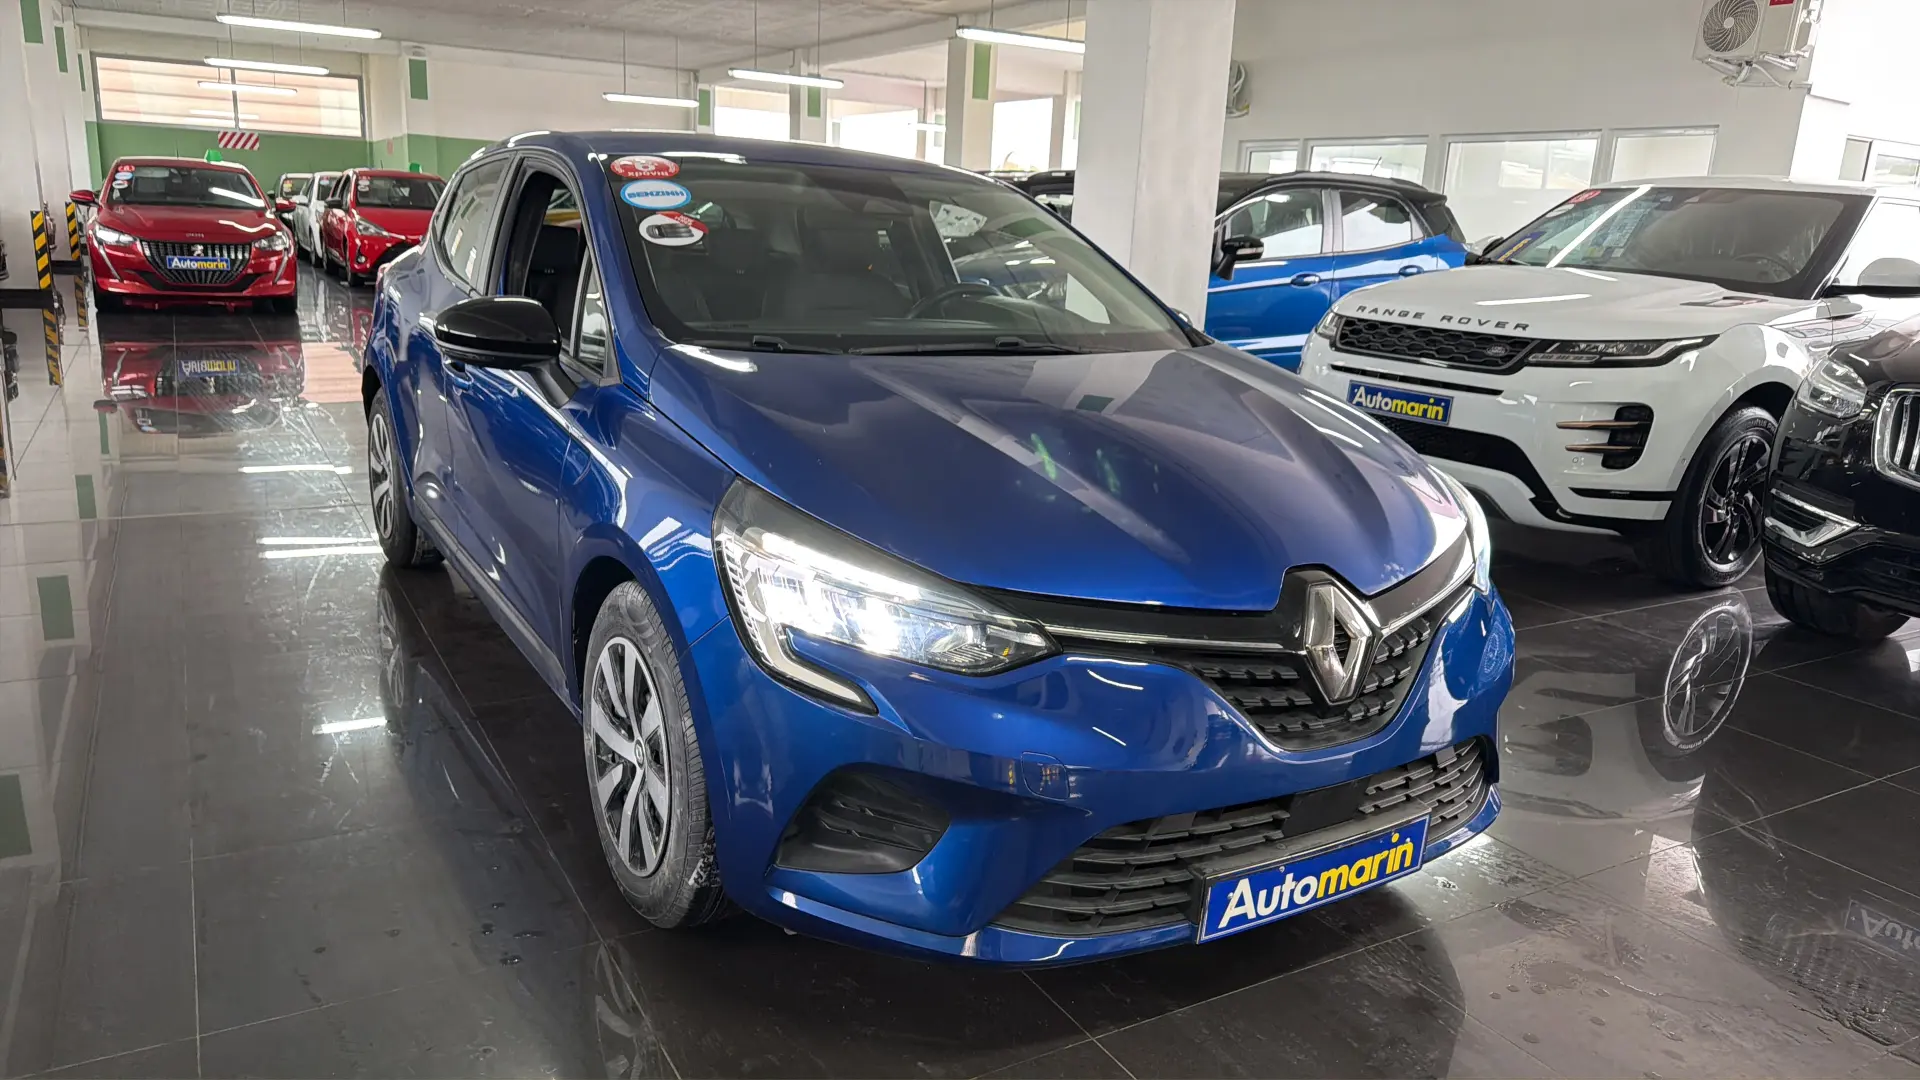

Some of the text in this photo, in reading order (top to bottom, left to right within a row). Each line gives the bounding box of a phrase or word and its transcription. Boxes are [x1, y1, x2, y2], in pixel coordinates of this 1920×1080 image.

[171, 257, 227, 269] Automarin
[1356, 305, 1530, 331] RANGE ROVER
[1353, 386, 1444, 420] Automarin
[1217, 833, 1414, 928] Automarin
